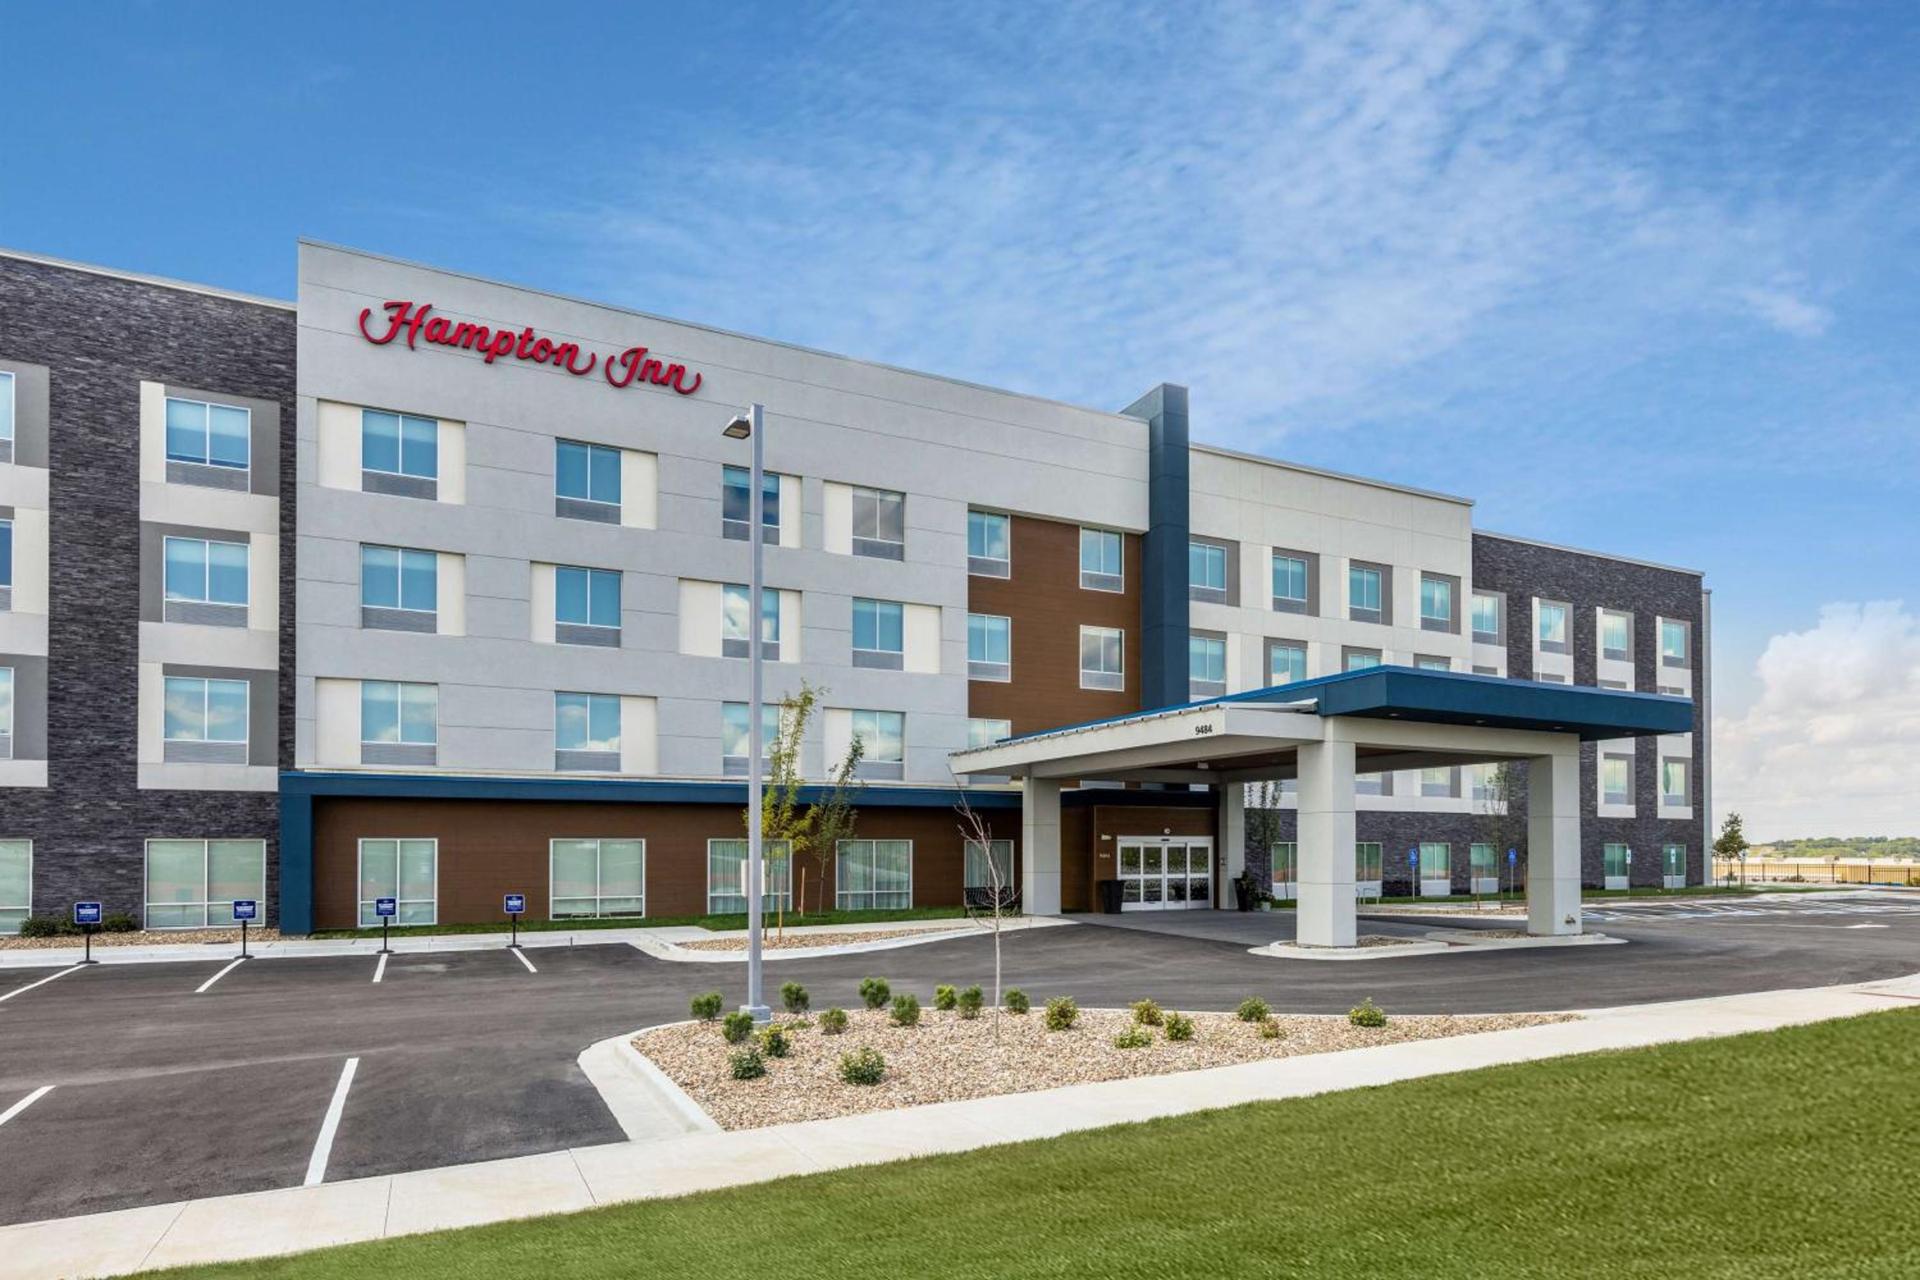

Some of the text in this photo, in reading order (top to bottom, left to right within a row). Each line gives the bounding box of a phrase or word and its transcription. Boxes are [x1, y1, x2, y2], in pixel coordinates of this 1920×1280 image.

[358, 300, 702, 395] Hampton Inn
[1195, 724, 1213, 736] 9484
